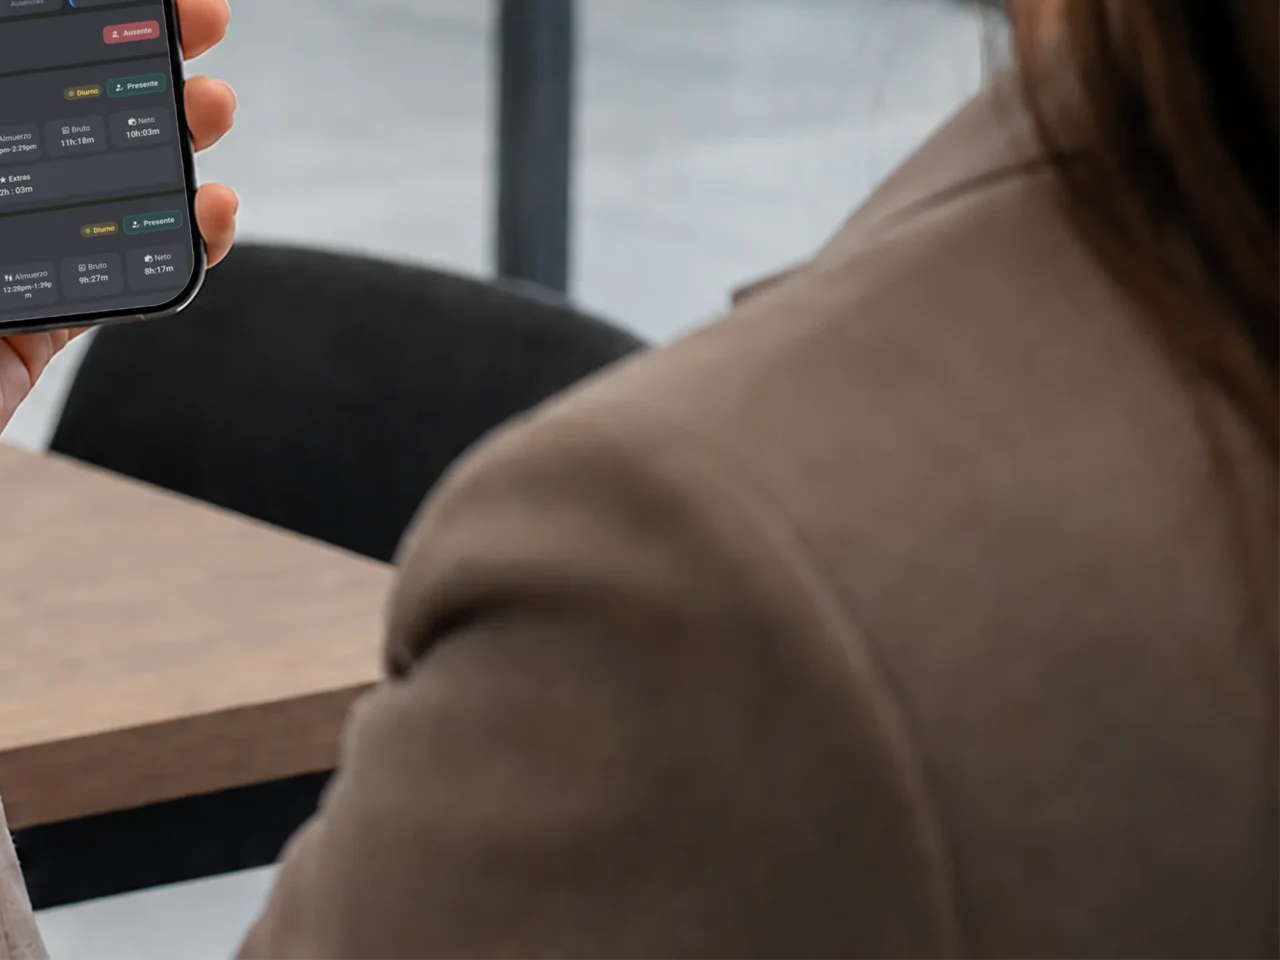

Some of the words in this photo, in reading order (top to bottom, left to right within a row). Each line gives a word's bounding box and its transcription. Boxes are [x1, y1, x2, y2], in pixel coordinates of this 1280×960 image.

[123, 27, 152, 37] Ausente
[127, 80, 159, 90] Presente
[77, 88, 98, 96] Diurno
[71, 125, 91, 133] Bruto
[126, 128, 160, 139] 10h:03m
[60, 136, 95, 147] 11h:18m
[0, 188, 10, 196] 2h
[15, 186, 33, 194] 03m
[144, 217, 175, 227] Presente
[93, 225, 115, 234] Diurno
[154, 254, 172, 262] Neto
[88, 262, 107, 270] Bruto
[145, 265, 174, 276] 8h:17m
[15, 271, 48, 280] Almuerzo
[79, 274, 108, 284] 9h:27m
